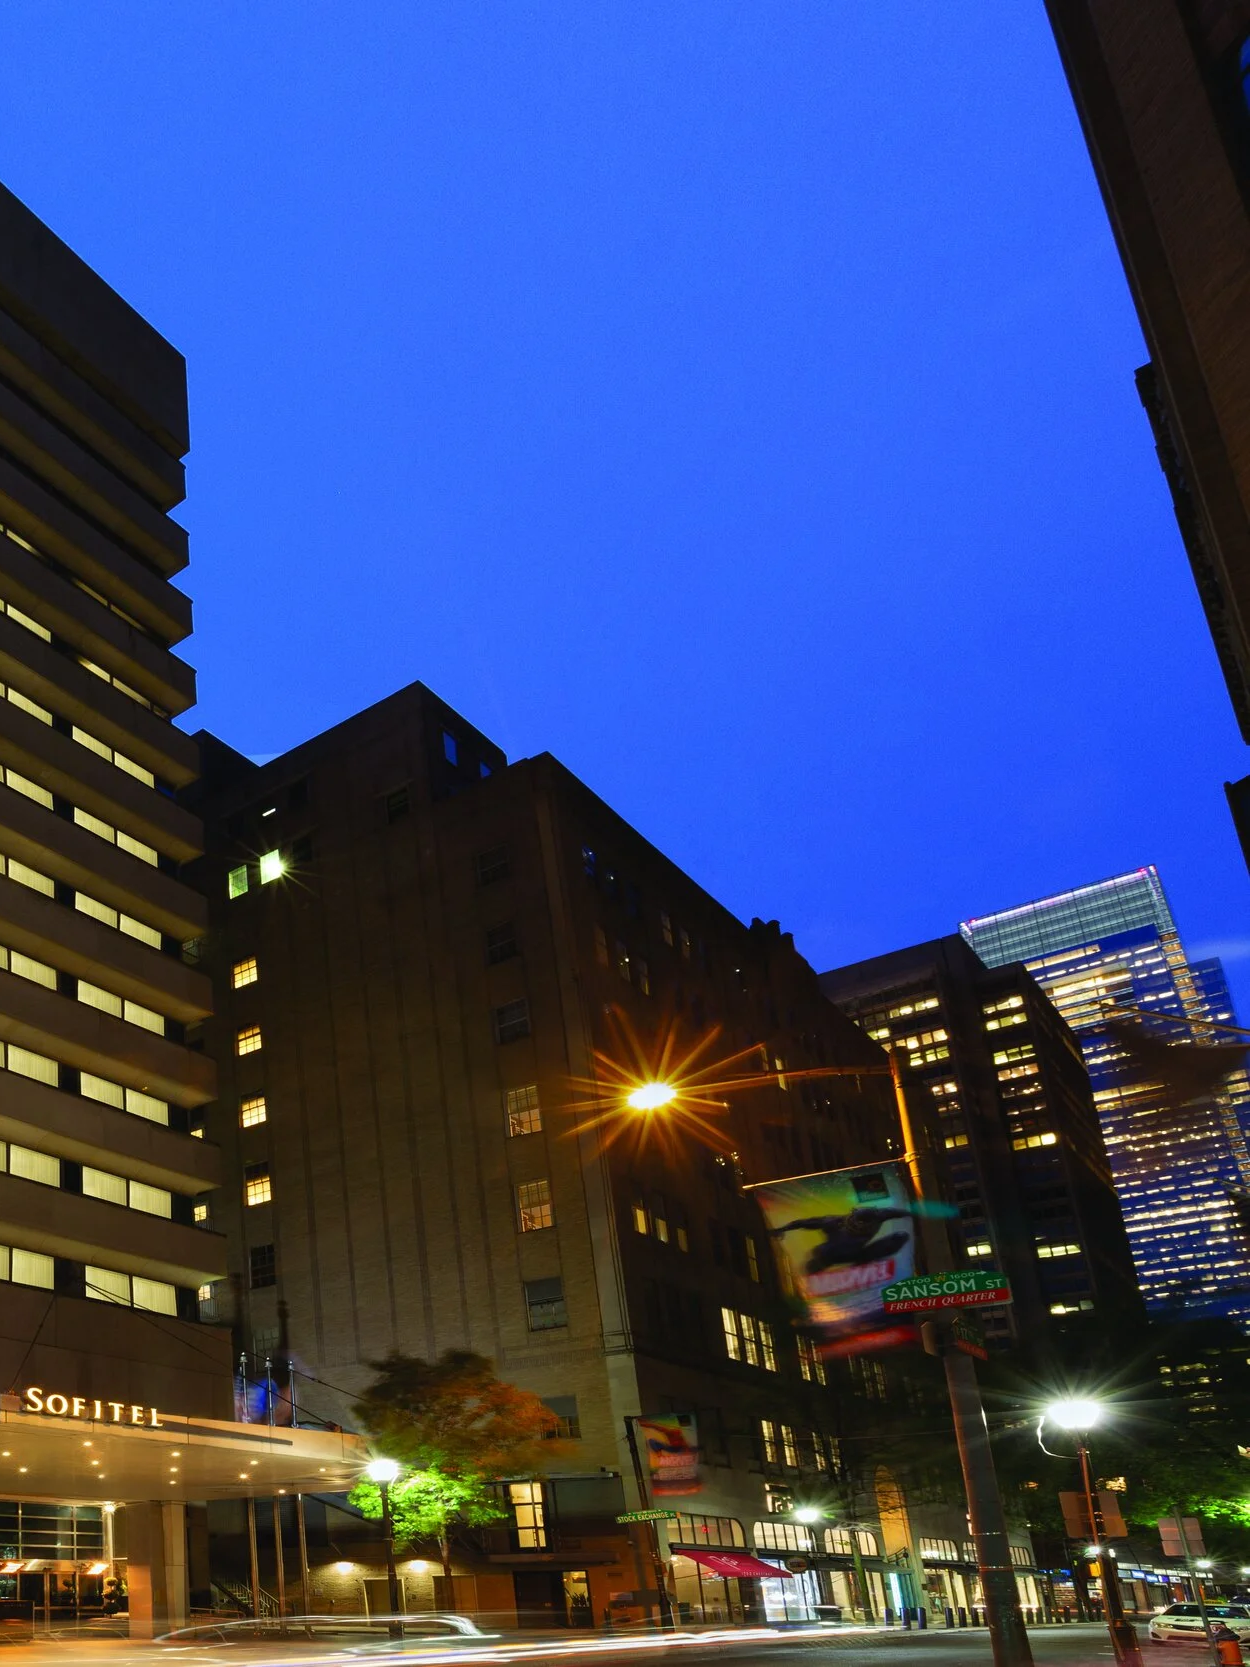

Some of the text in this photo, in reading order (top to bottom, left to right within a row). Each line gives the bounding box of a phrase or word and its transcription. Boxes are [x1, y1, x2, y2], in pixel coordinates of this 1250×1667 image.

[907, 1277, 931, 1286] 1700
[950, 1271, 975, 1280] 1600
[885, 1278, 1003, 1301] SANSOM ST
[890, 1298, 937, 1312] FRENCH
[941, 1292, 997, 1306] QUARTER
[25, 1387, 163, 1427] SOFITEL
[617, 1515, 636, 1523] STOCK
[637, 1512, 669, 1521] EXCHANGE
